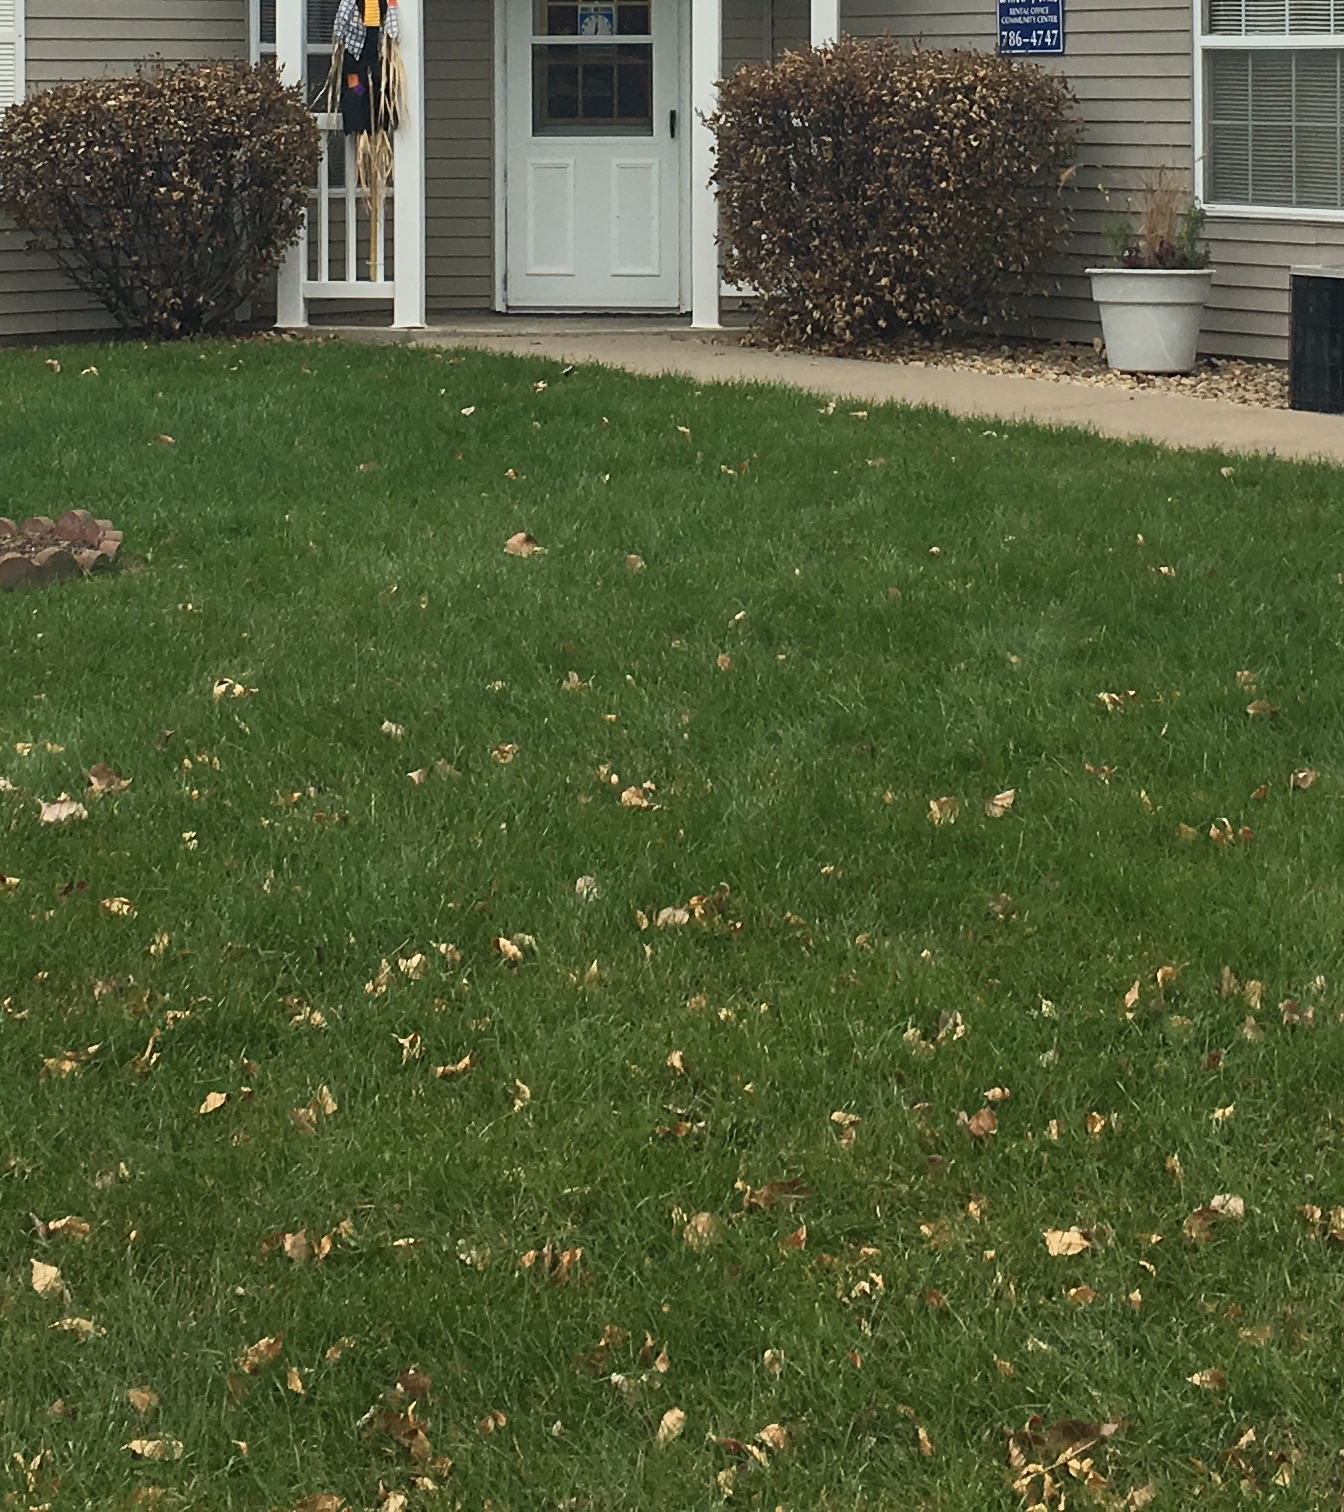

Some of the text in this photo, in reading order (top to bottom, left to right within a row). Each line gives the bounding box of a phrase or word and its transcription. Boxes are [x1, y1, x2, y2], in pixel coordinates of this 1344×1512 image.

[1001, 15, 1058, 24] COMMUNITY CENTER
[1001, 29, 1059, 47] 786-4747
